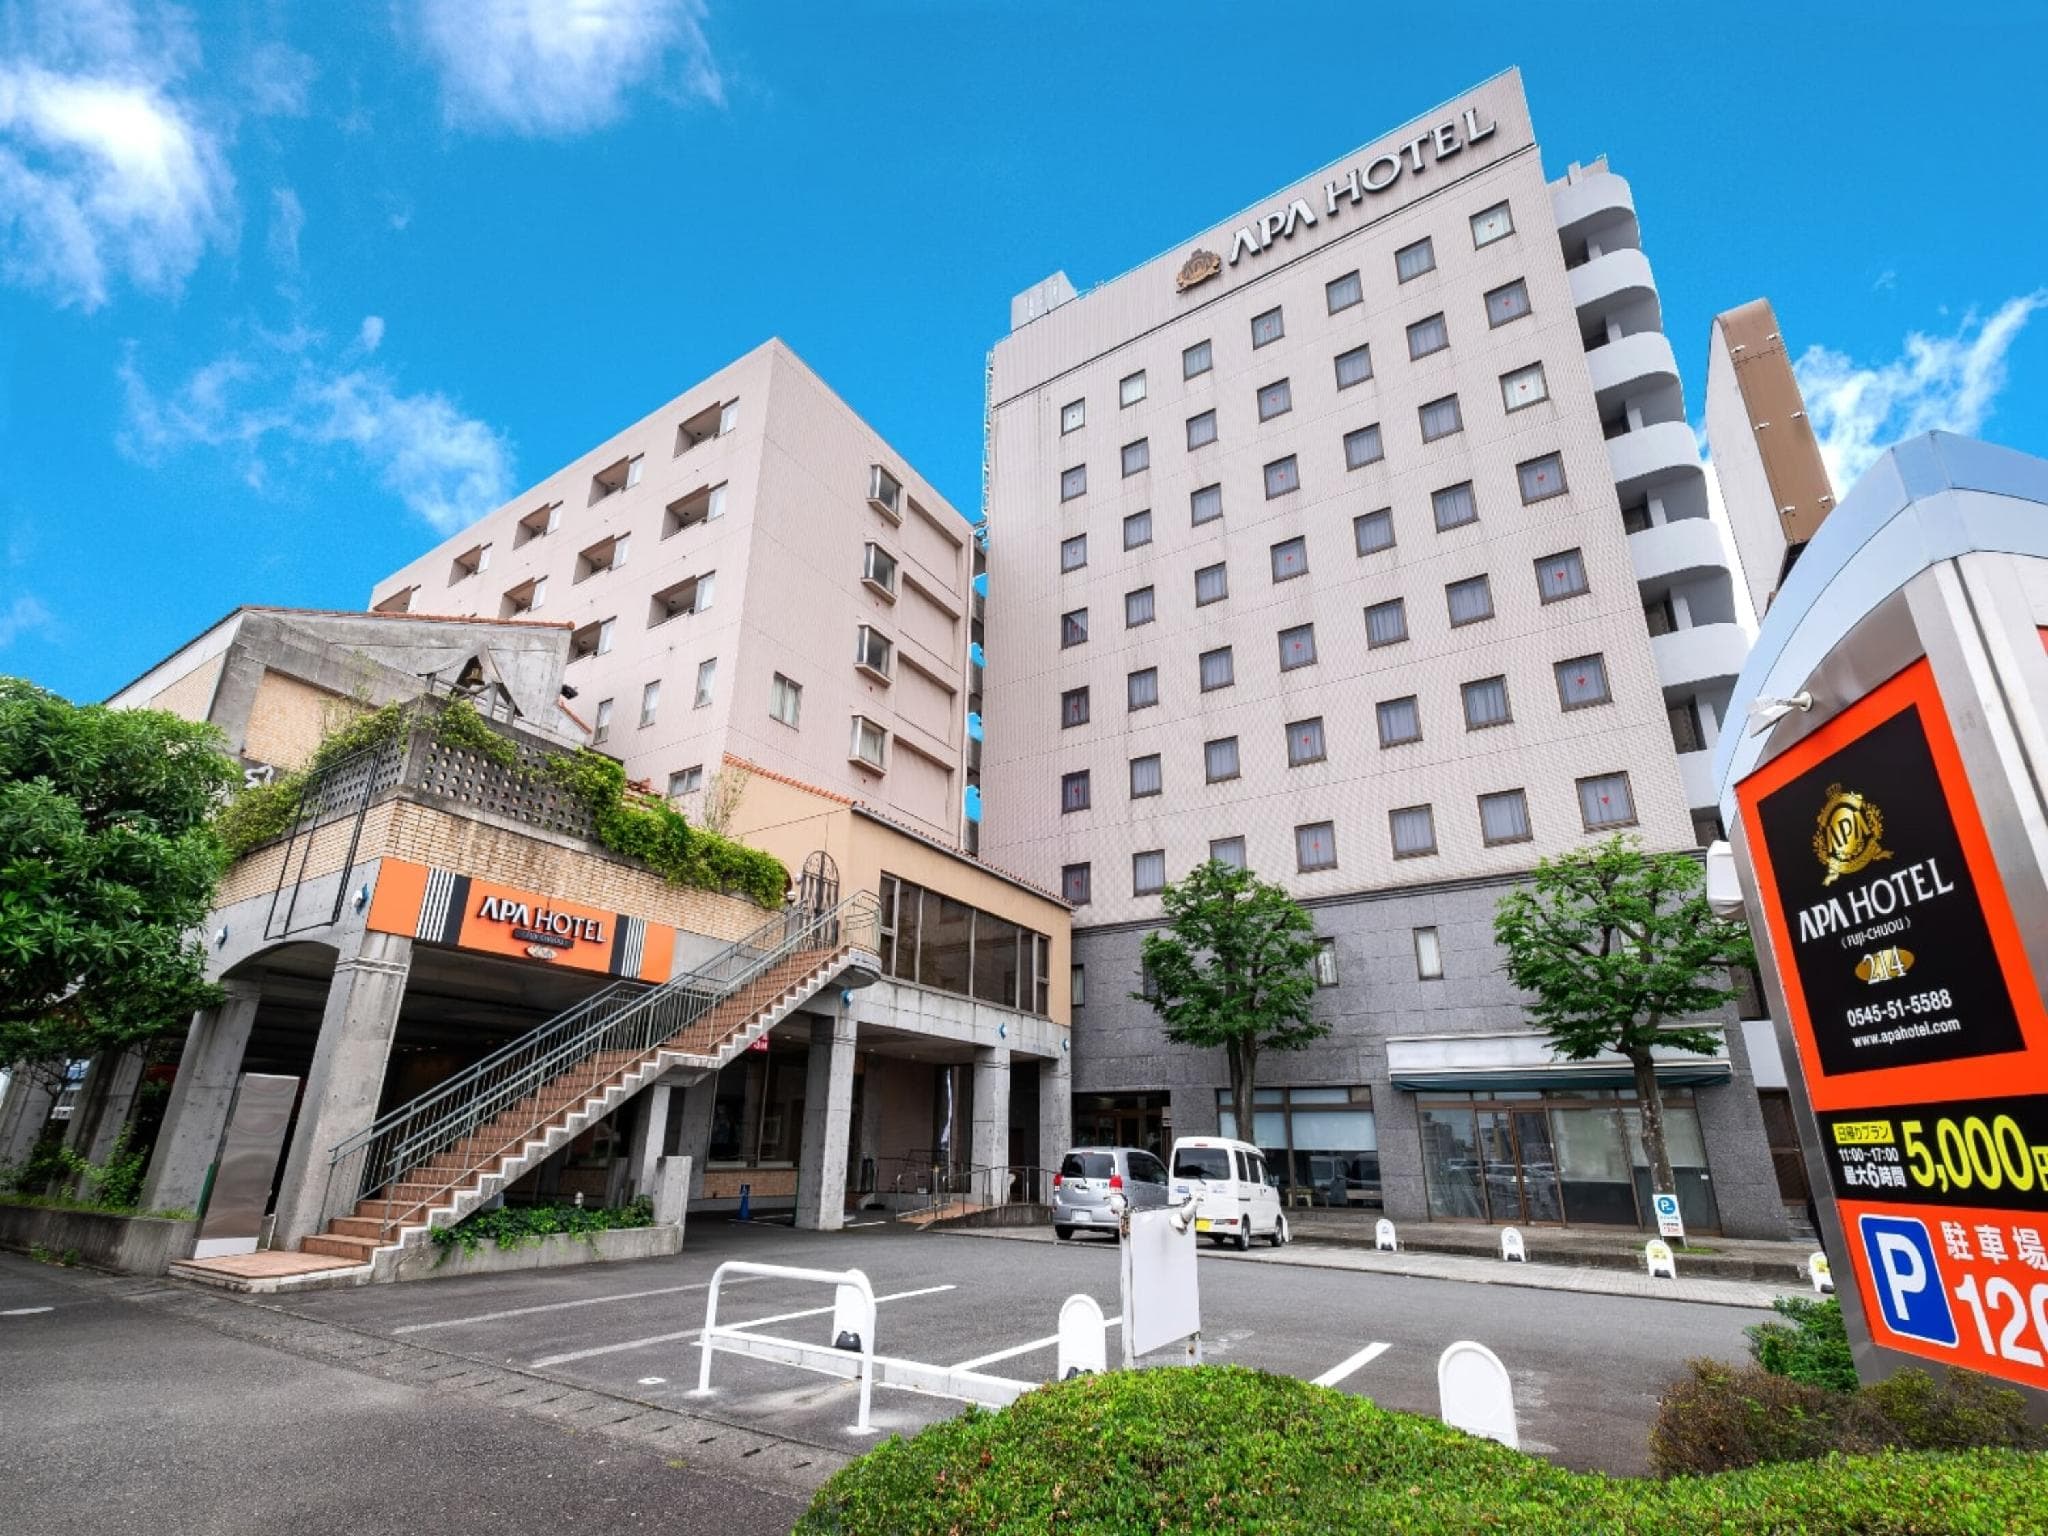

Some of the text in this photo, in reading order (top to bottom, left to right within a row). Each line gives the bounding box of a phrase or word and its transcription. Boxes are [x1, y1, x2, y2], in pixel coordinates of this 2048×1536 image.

[1229, 107, 1497, 266] APA HOTEL
[478, 895, 529, 927] APA
[534, 907, 607, 944] HOTEL
[1799, 858, 1954, 943] APA HOTEL
[1863, 945, 1907, 985] 214
[1846, 988, 1953, 1028] 0545-51-5588
[1852, 1018, 1961, 1048] www.apahotel.com
[1836, 1125, 1889, 1142] 日帰りプラン
[1843, 1161, 1908, 1189] 最大6時間
[1940, 1220, 2048, 1271] 駐車場
[1876, 1231, 1927, 1321] P
